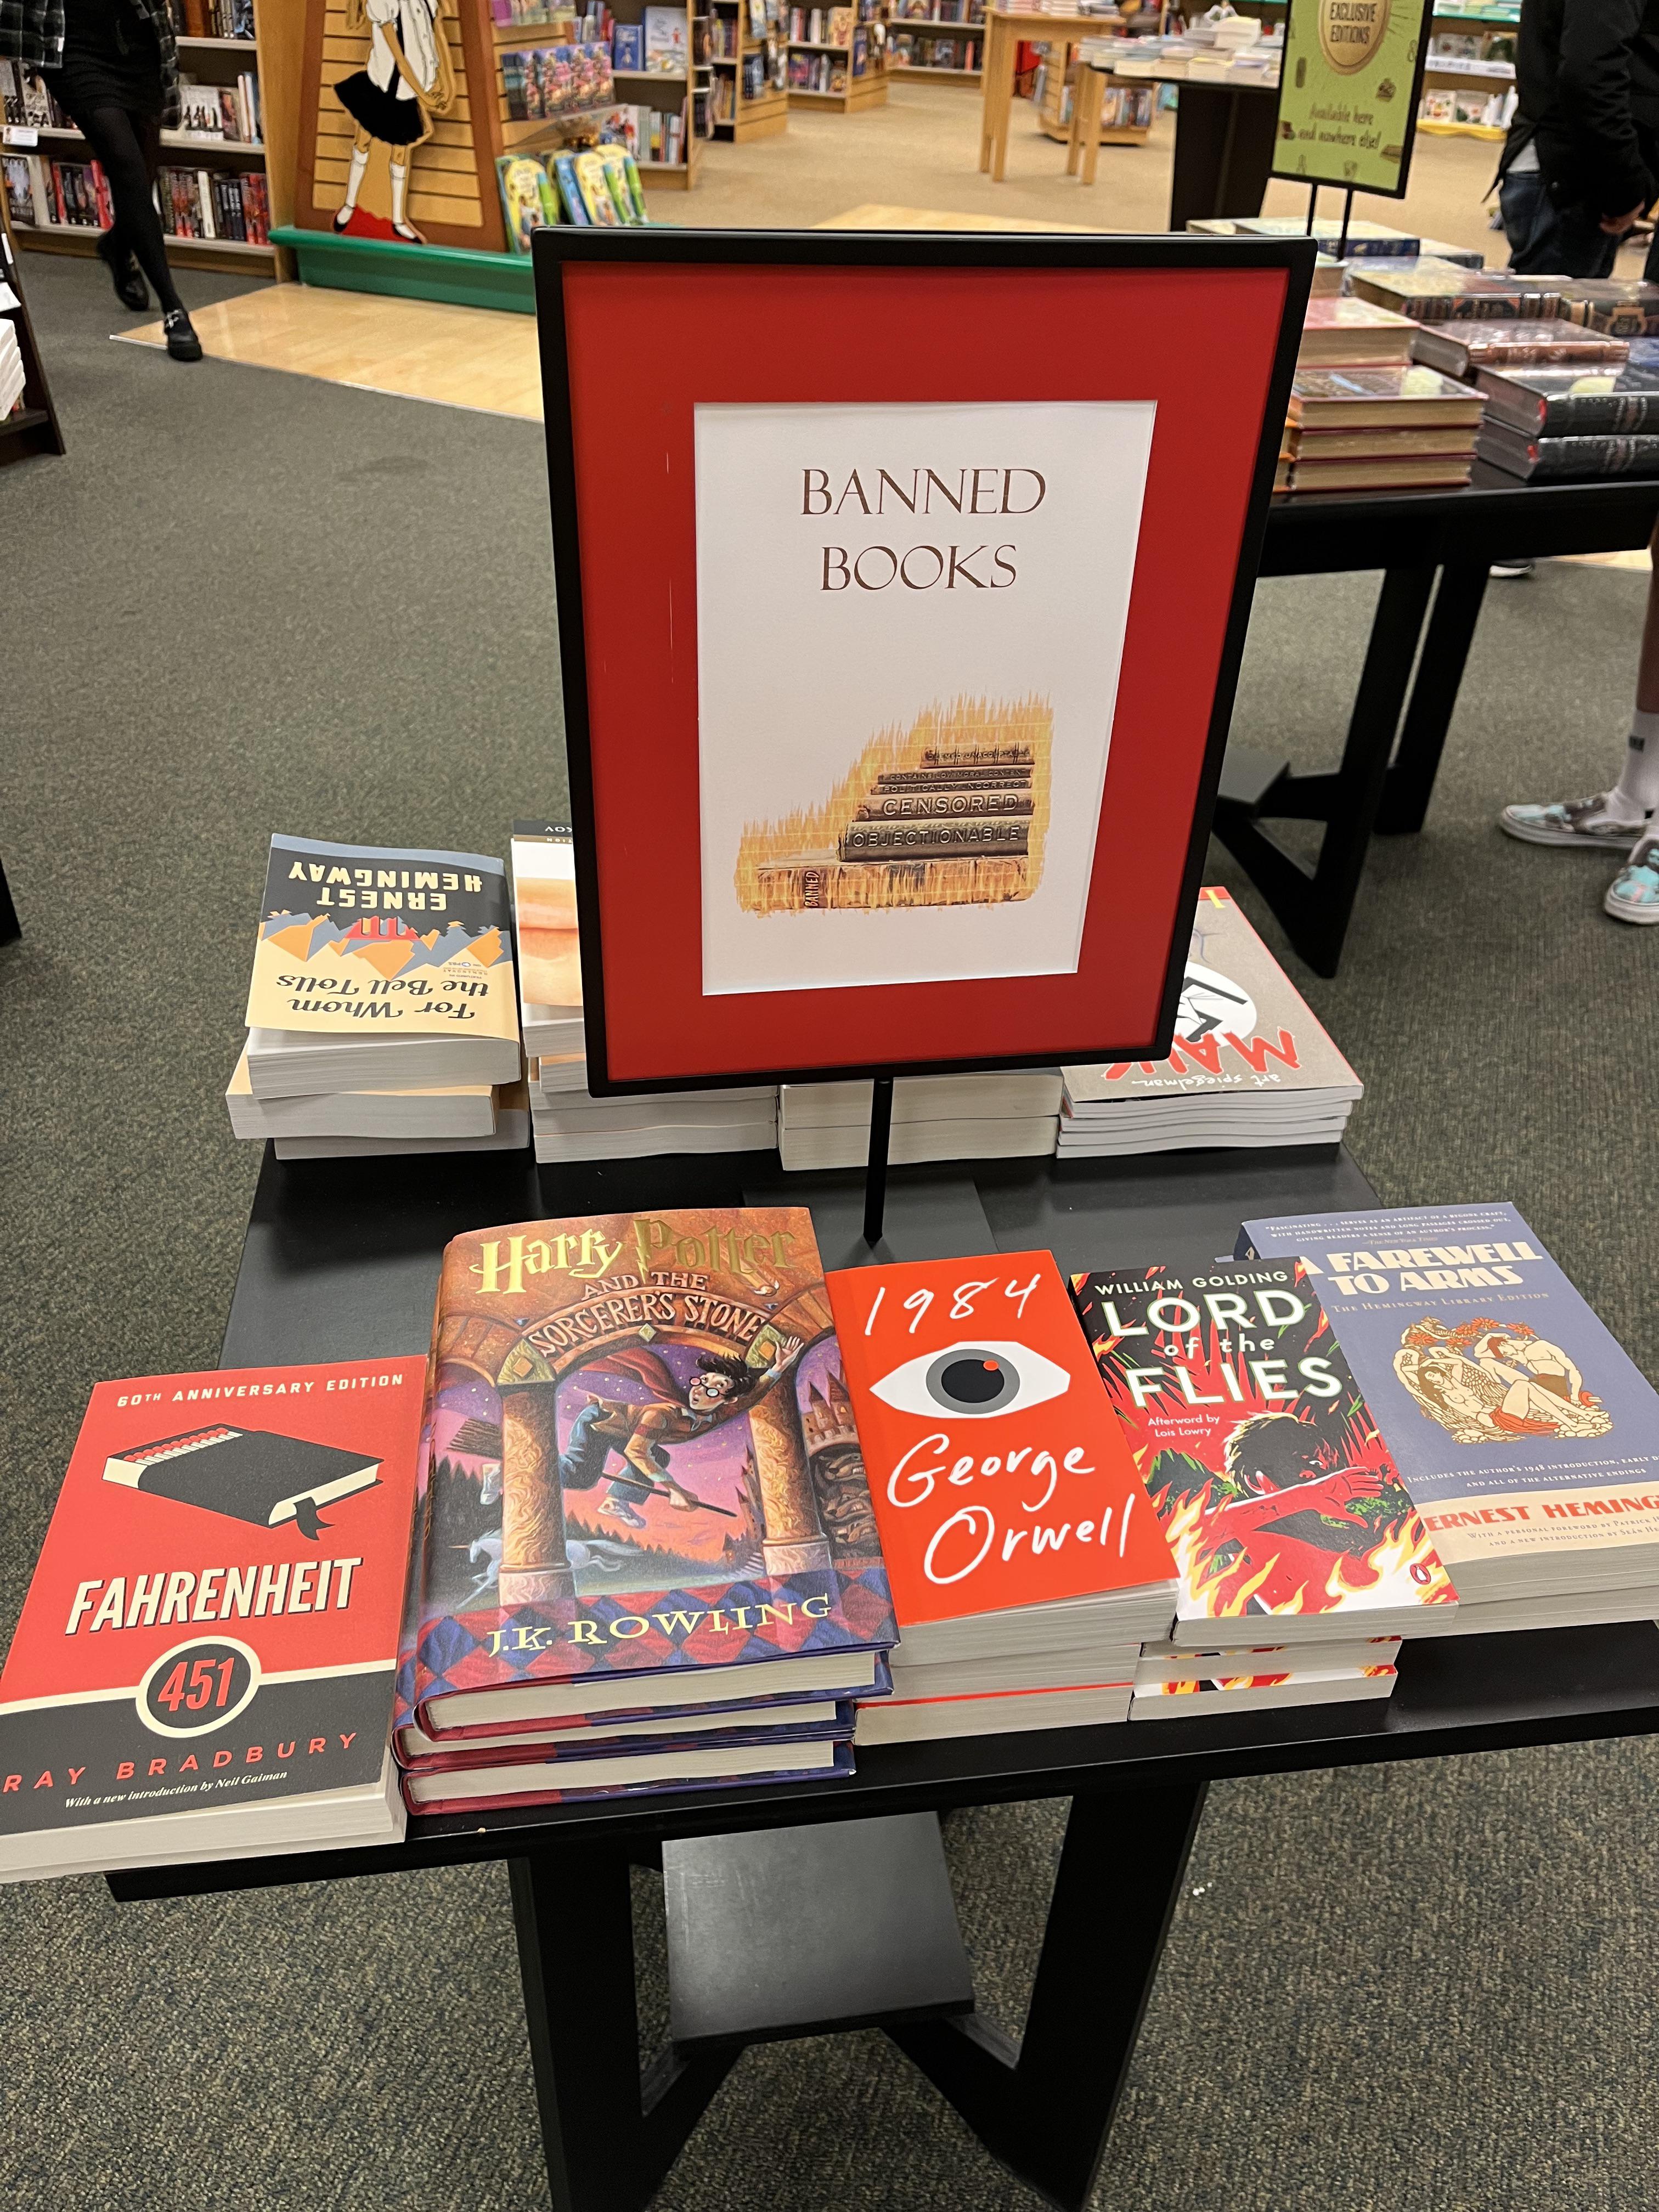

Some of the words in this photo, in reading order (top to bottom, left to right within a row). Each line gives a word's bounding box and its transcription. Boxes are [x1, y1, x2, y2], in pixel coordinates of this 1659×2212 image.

[1330, 25, 1370, 44] EDITIONS
[800, 467, 1047, 516] BANNED
[820, 544, 1018, 591] BOOKS
[884, 782, 958, 793] POLITICALLY
[882, 794, 1019, 817] CENSORED
[853, 825, 1020, 849] OBJECTIONABLE
[288, 861, 483, 893] HEMINGWAY
[804, 870, 820, 908] BANNED
[316, 887, 447, 911] ERNEST
[276, 975, 359, 996] Tolls
[367, 979, 433, 996] Bell
[440, 980, 489, 996] the
[286, 998, 403, 1019] Whom
[414, 1002, 475, 1019] For
[1131, 1074, 1243, 1091] spiegelman
[1250, 1074, 1281, 1087] art
[469, 1228, 623, 1295] Harry
[633, 1218, 799, 1285] Potter
[1326, 1242, 1543, 1273] FAREWELL
[581, 1274, 640, 1301] AND
[651, 1271, 710, 1290] THE
[1095, 1279, 1183, 1296] WILLIAM
[1192, 1271, 1288, 1289] GOLDING
[1328, 1273, 1390, 1295] TO
[1400, 1265, 1523, 1291] ARMS
[865, 1273, 1041, 1336] 1984
[1101, 1289, 1306, 1337] LORD
[1331, 1305, 1357, 1313] THE
[1362, 1299, 1437, 1311] HEMINGWAY
[1441, 1296, 1493, 1306] LIBRARY
[1497, 1292, 1549, 1302] EDITION
[528, 1290, 676, 1357] SORCERER'S
[684, 1295, 766, 1341] STONE
[1164, 1336, 1200, 1359] of
[1220, 1333, 1275, 1353] the
[116, 1392, 161, 1408] 60TH
[172, 1381, 315, 1402] ANNIVERSARY
[326, 1374, 403, 1392] EDITION
[1125, 1356, 1342, 1408] FLIES
[1148, 1414, 1203, 1426] Afterword
[1206, 1414, 1220, 1424] by
[1155, 1428, 1175, 1437] Lois
[1178, 1427, 1211, 1436] Lowry
[887, 1433, 1096, 1512] George
[1407, 1472, 1454, 1483] INCLUDES
[1479, 1465, 1522, 1475] AUTHOR'S
[1524, 1464, 1545, 1472] 1948
[1547, 1459, 1619, 1470] INTRODUCTION,
[1543, 1472, 1605, 1482] ALTERNATIVE
[1606, 1468, 1646, 1477] ENDINGS
[1424, 1506, 1530, 1531] ERNEST
[1542, 1495, 1659, 1518] HEMING
[924, 1493, 1135, 1584] Orwell
[1539, 1533, 1605, 1541] INTRODUCTION
[64, 1557, 363, 1637] FAHRENHEIT
[486, 1625, 554, 1658] J.K.
[567, 1593, 832, 1644] ROWLING
[157, 1657, 235, 1712] 451
[2, 1767, 87, 1792] RAY
[115, 1733, 359, 1780] BRADBURY
[65, 1796, 92, 1809] With
[93, 1797, 101, 1805] a
[103, 1793, 127, 1803] new
[127, 1783, 198, 1801] introduction
[199, 1780, 214, 1792] by
[215, 1776, 240, 1789] Neil
[241, 1771, 288, 1785] Gaiman
